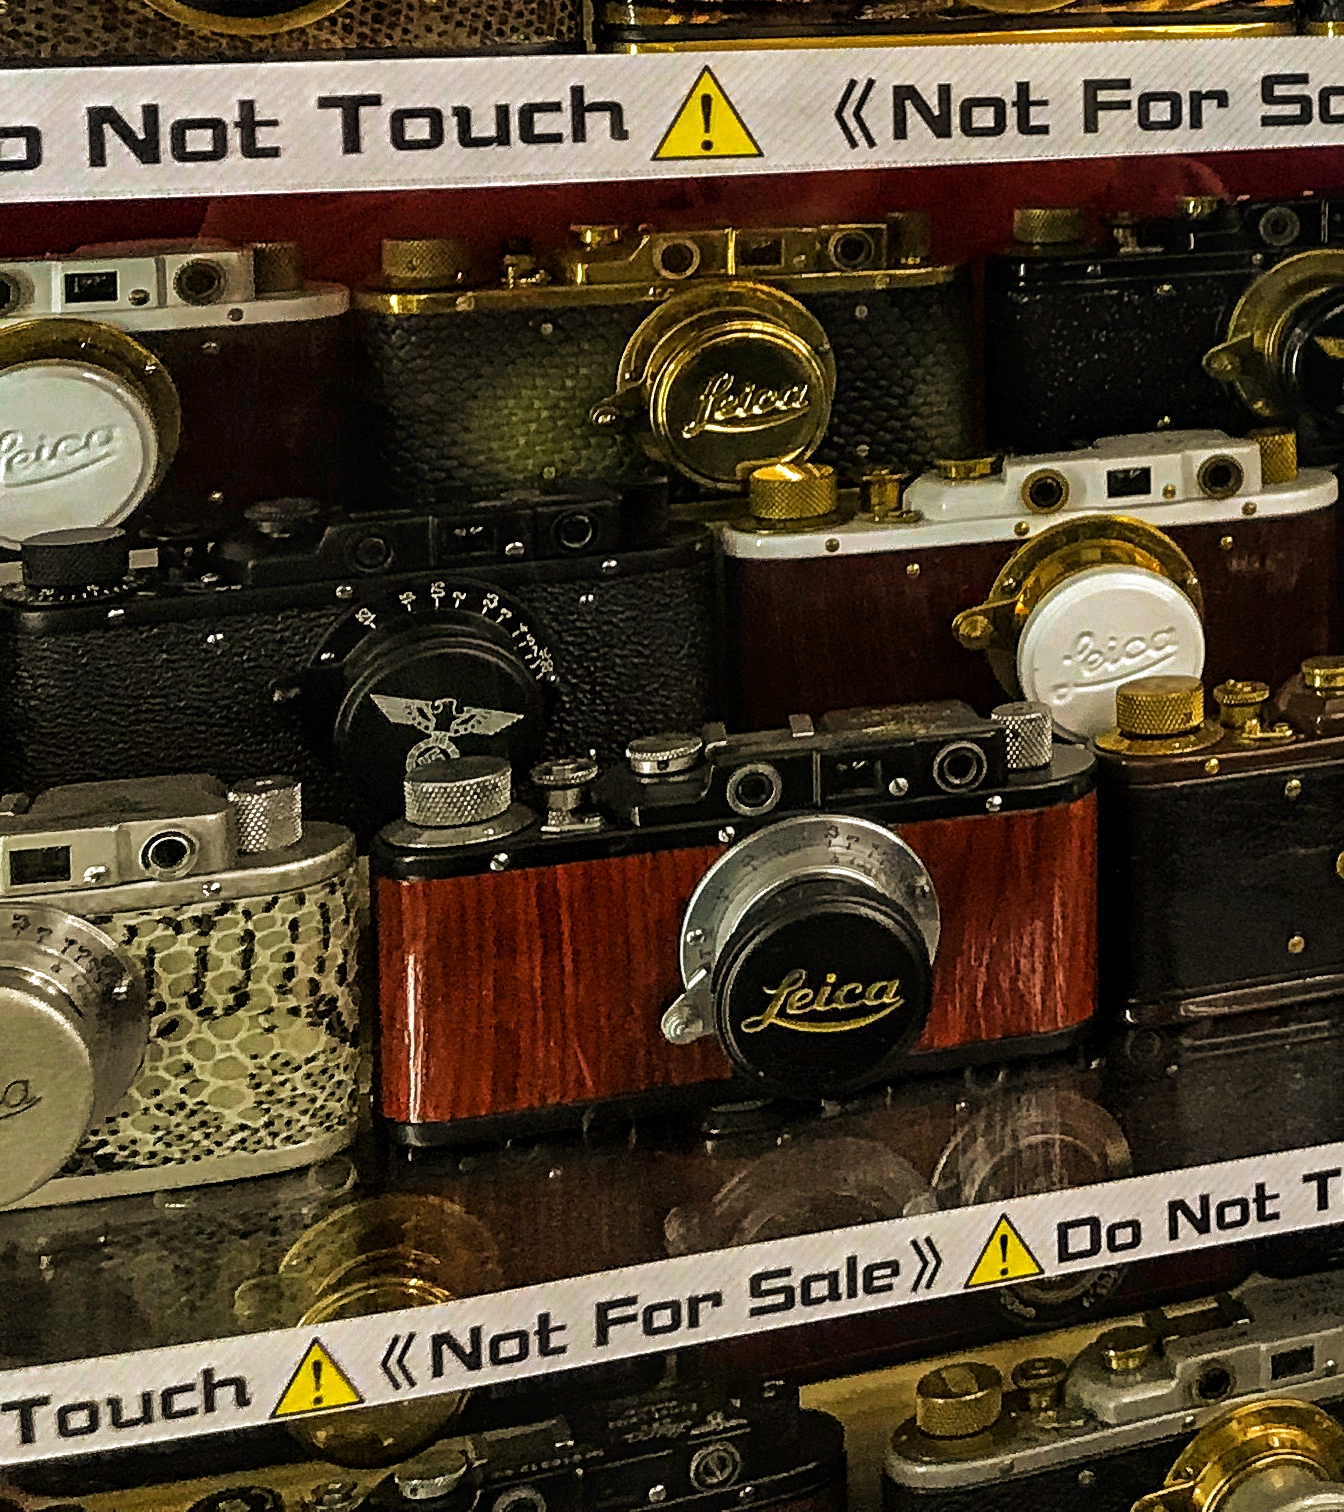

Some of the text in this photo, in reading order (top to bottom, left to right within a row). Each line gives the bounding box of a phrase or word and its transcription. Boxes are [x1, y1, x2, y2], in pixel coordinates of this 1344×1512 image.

[87, 98, 281, 169] Not
[318, 84, 630, 156] Touch
[1082, 77, 1230, 135] For
[681, 372, 809, 440] Leica
[1052, 622, 1182, 701] Leica
[739, 967, 907, 1035] Leica
[1, 1367, 252, 1446] Touch
[594, 1292, 724, 1347] For
[1057, 1215, 1142, 1264] Do
[1168, 1182, 1281, 1242] Not
